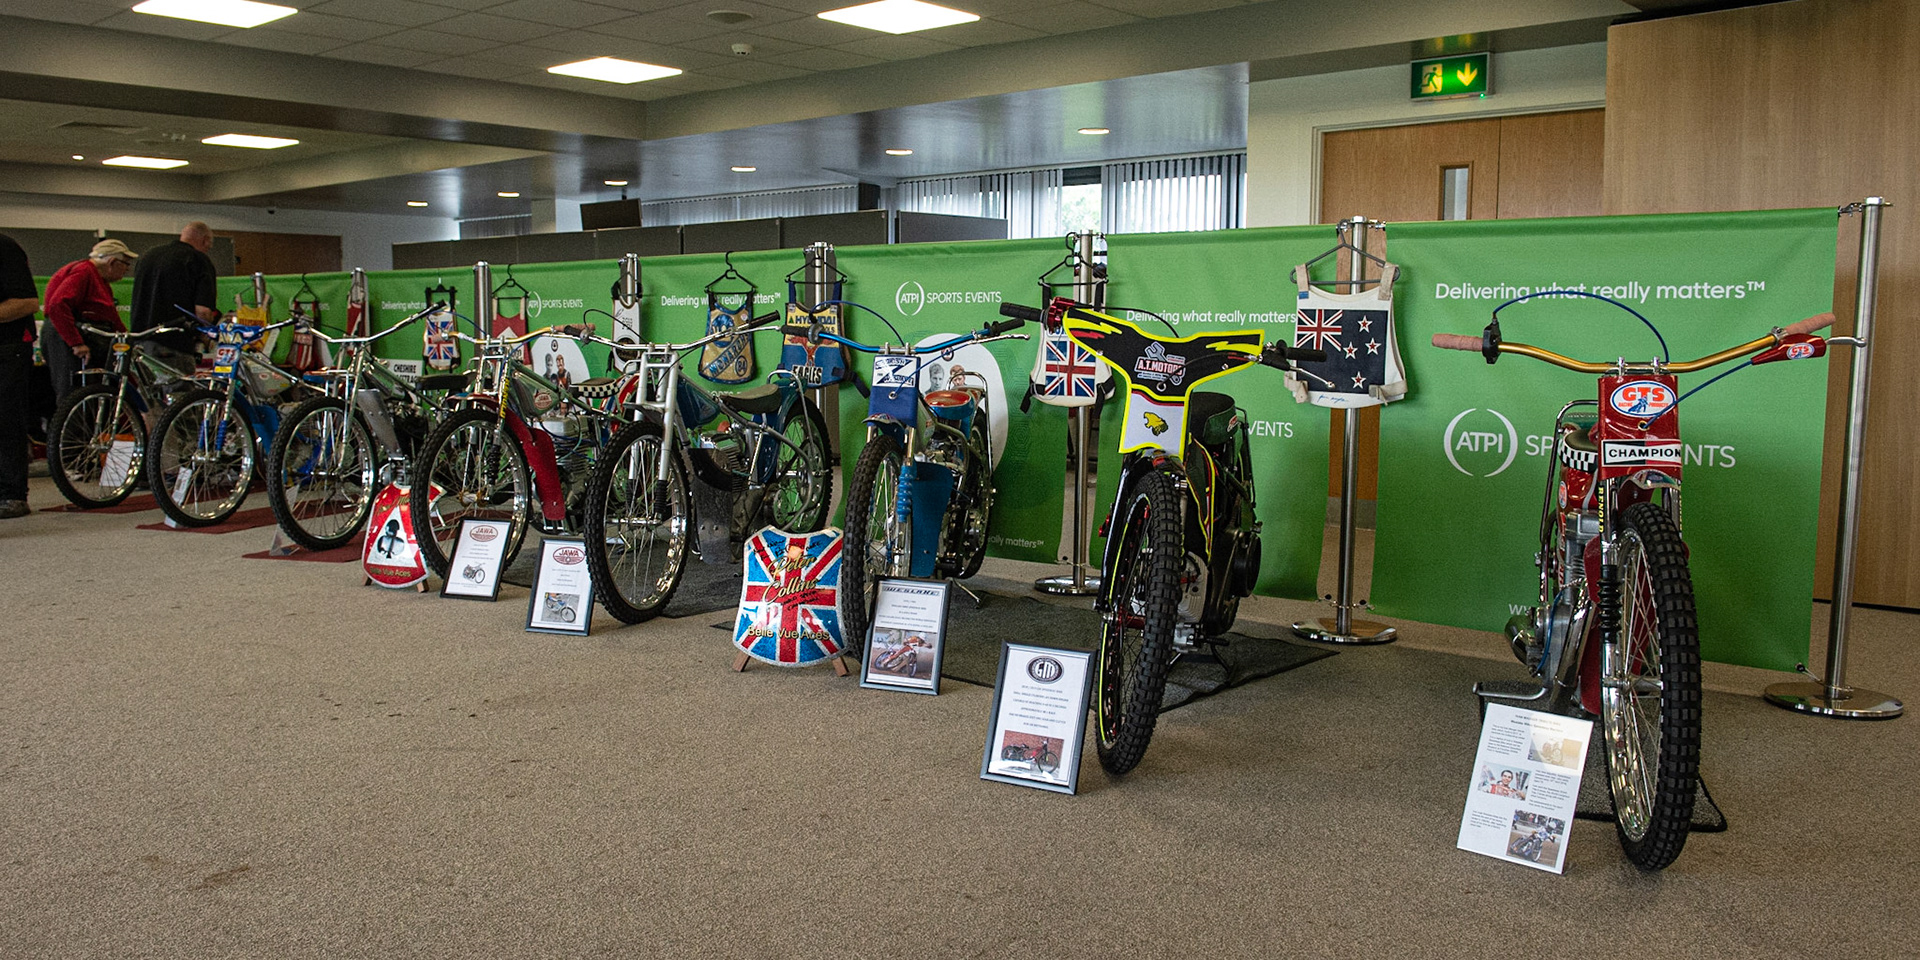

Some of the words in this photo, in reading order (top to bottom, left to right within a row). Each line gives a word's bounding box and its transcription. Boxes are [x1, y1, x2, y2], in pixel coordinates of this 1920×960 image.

[661, 295, 700, 309] Delivering
[721, 294, 744, 308] really
[747, 292, 781, 305] atters™
[901, 293, 920, 303] ATPI
[926, 292, 962, 304] SPORTS
[965, 291, 1001, 303] EVENTS
[1435, 282, 1530, 304] Delivering
[1536, 281, 1587, 299] what
[1593, 282, 1647, 304] really
[1656, 280, 1766, 299] matters™
[542, 299, 562, 309] SPORTS
[563, 299, 583, 308] EVENTS
[1126, 310, 1180, 326] Delivering
[1183, 309, 1211, 323] what
[1214, 310, 1246, 326] really
[793, 365, 823, 385] EAGLES
[1622, 387, 1665, 402] GTS
[1248, 420, 1294, 438] VENTS
[1456, 431, 1504, 453] ATPI
[1608, 448, 1681, 458] CHAMPION
[558, 549, 580, 557] JAWA
[767, 553, 818, 578] Peter
[762, 576, 820, 605] Collins
[747, 625, 774, 638] Belle
[778, 627, 799, 639] Vue
[800, 630, 830, 641] Aces
